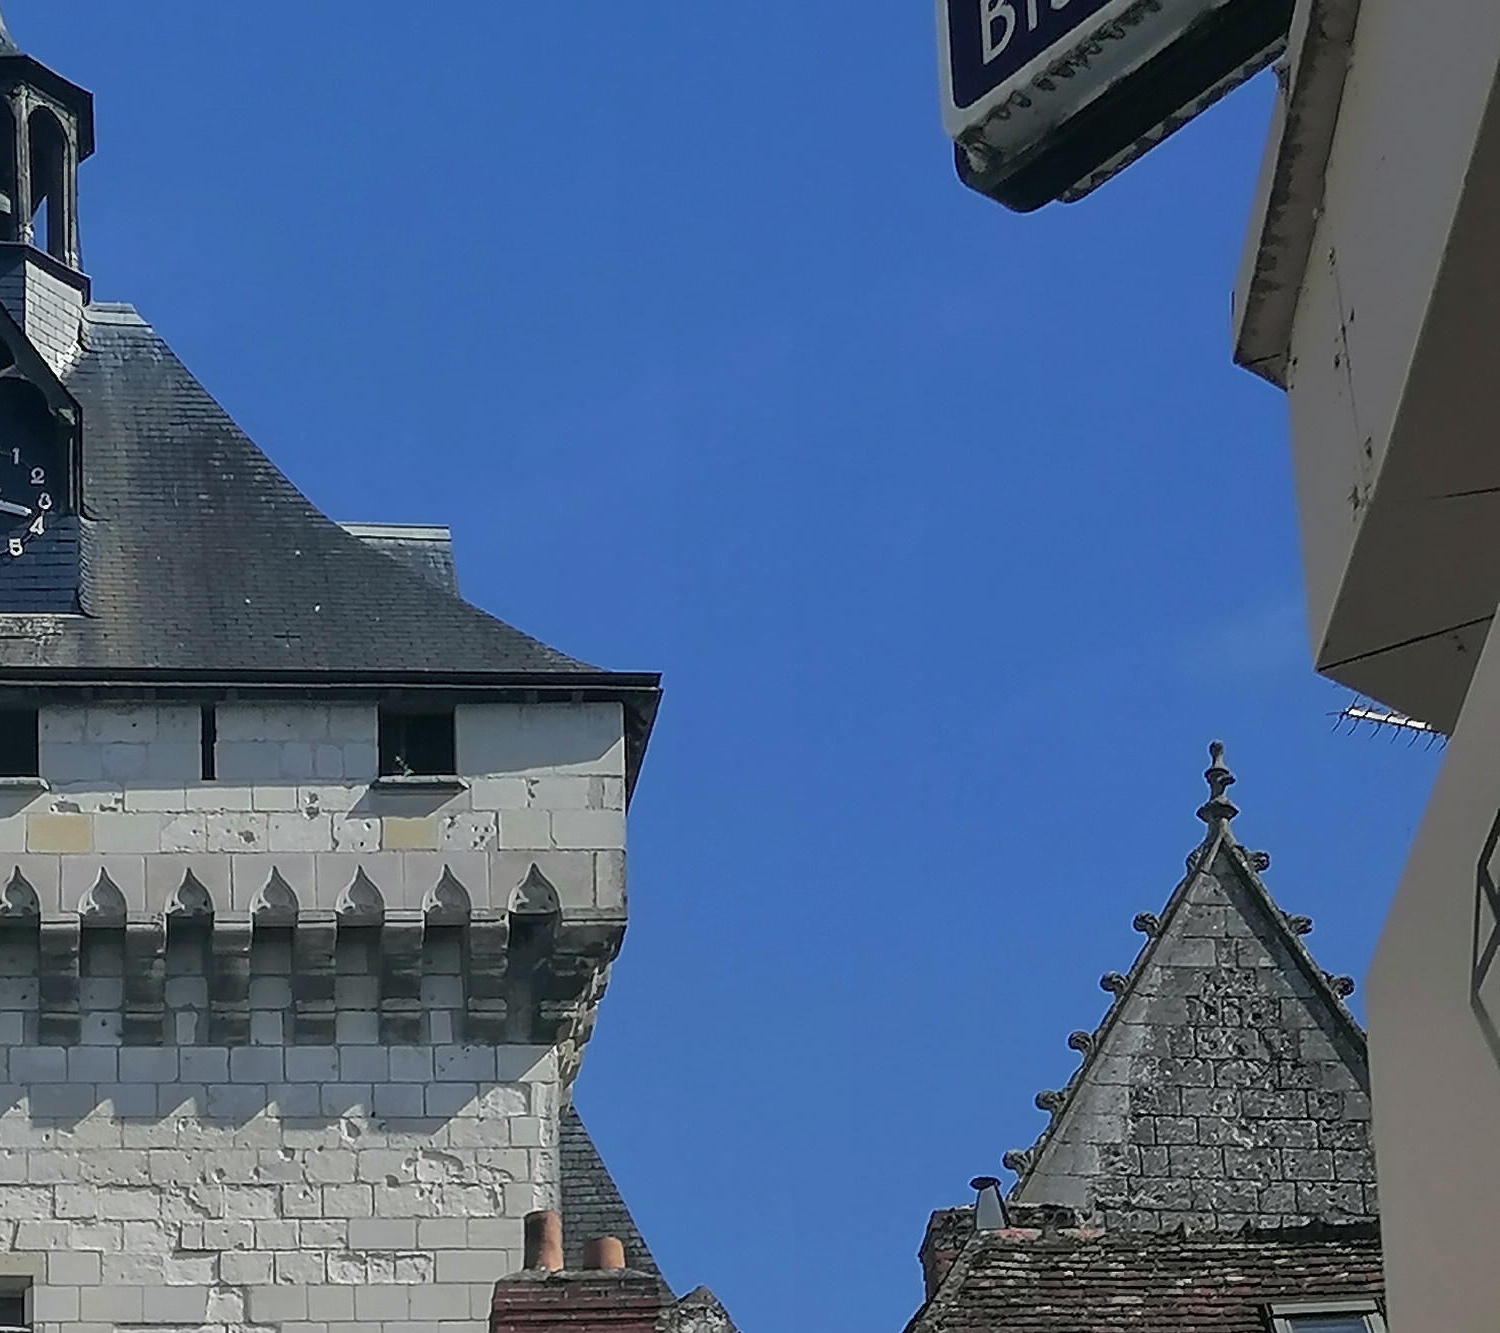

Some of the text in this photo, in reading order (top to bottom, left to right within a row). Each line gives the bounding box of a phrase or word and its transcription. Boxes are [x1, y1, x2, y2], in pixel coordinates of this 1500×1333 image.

[12, 448, 20, 465] 1
[31, 468, 45, 484] 2
[29, 516, 44, 535] 4
[9, 538, 23, 556] 5
